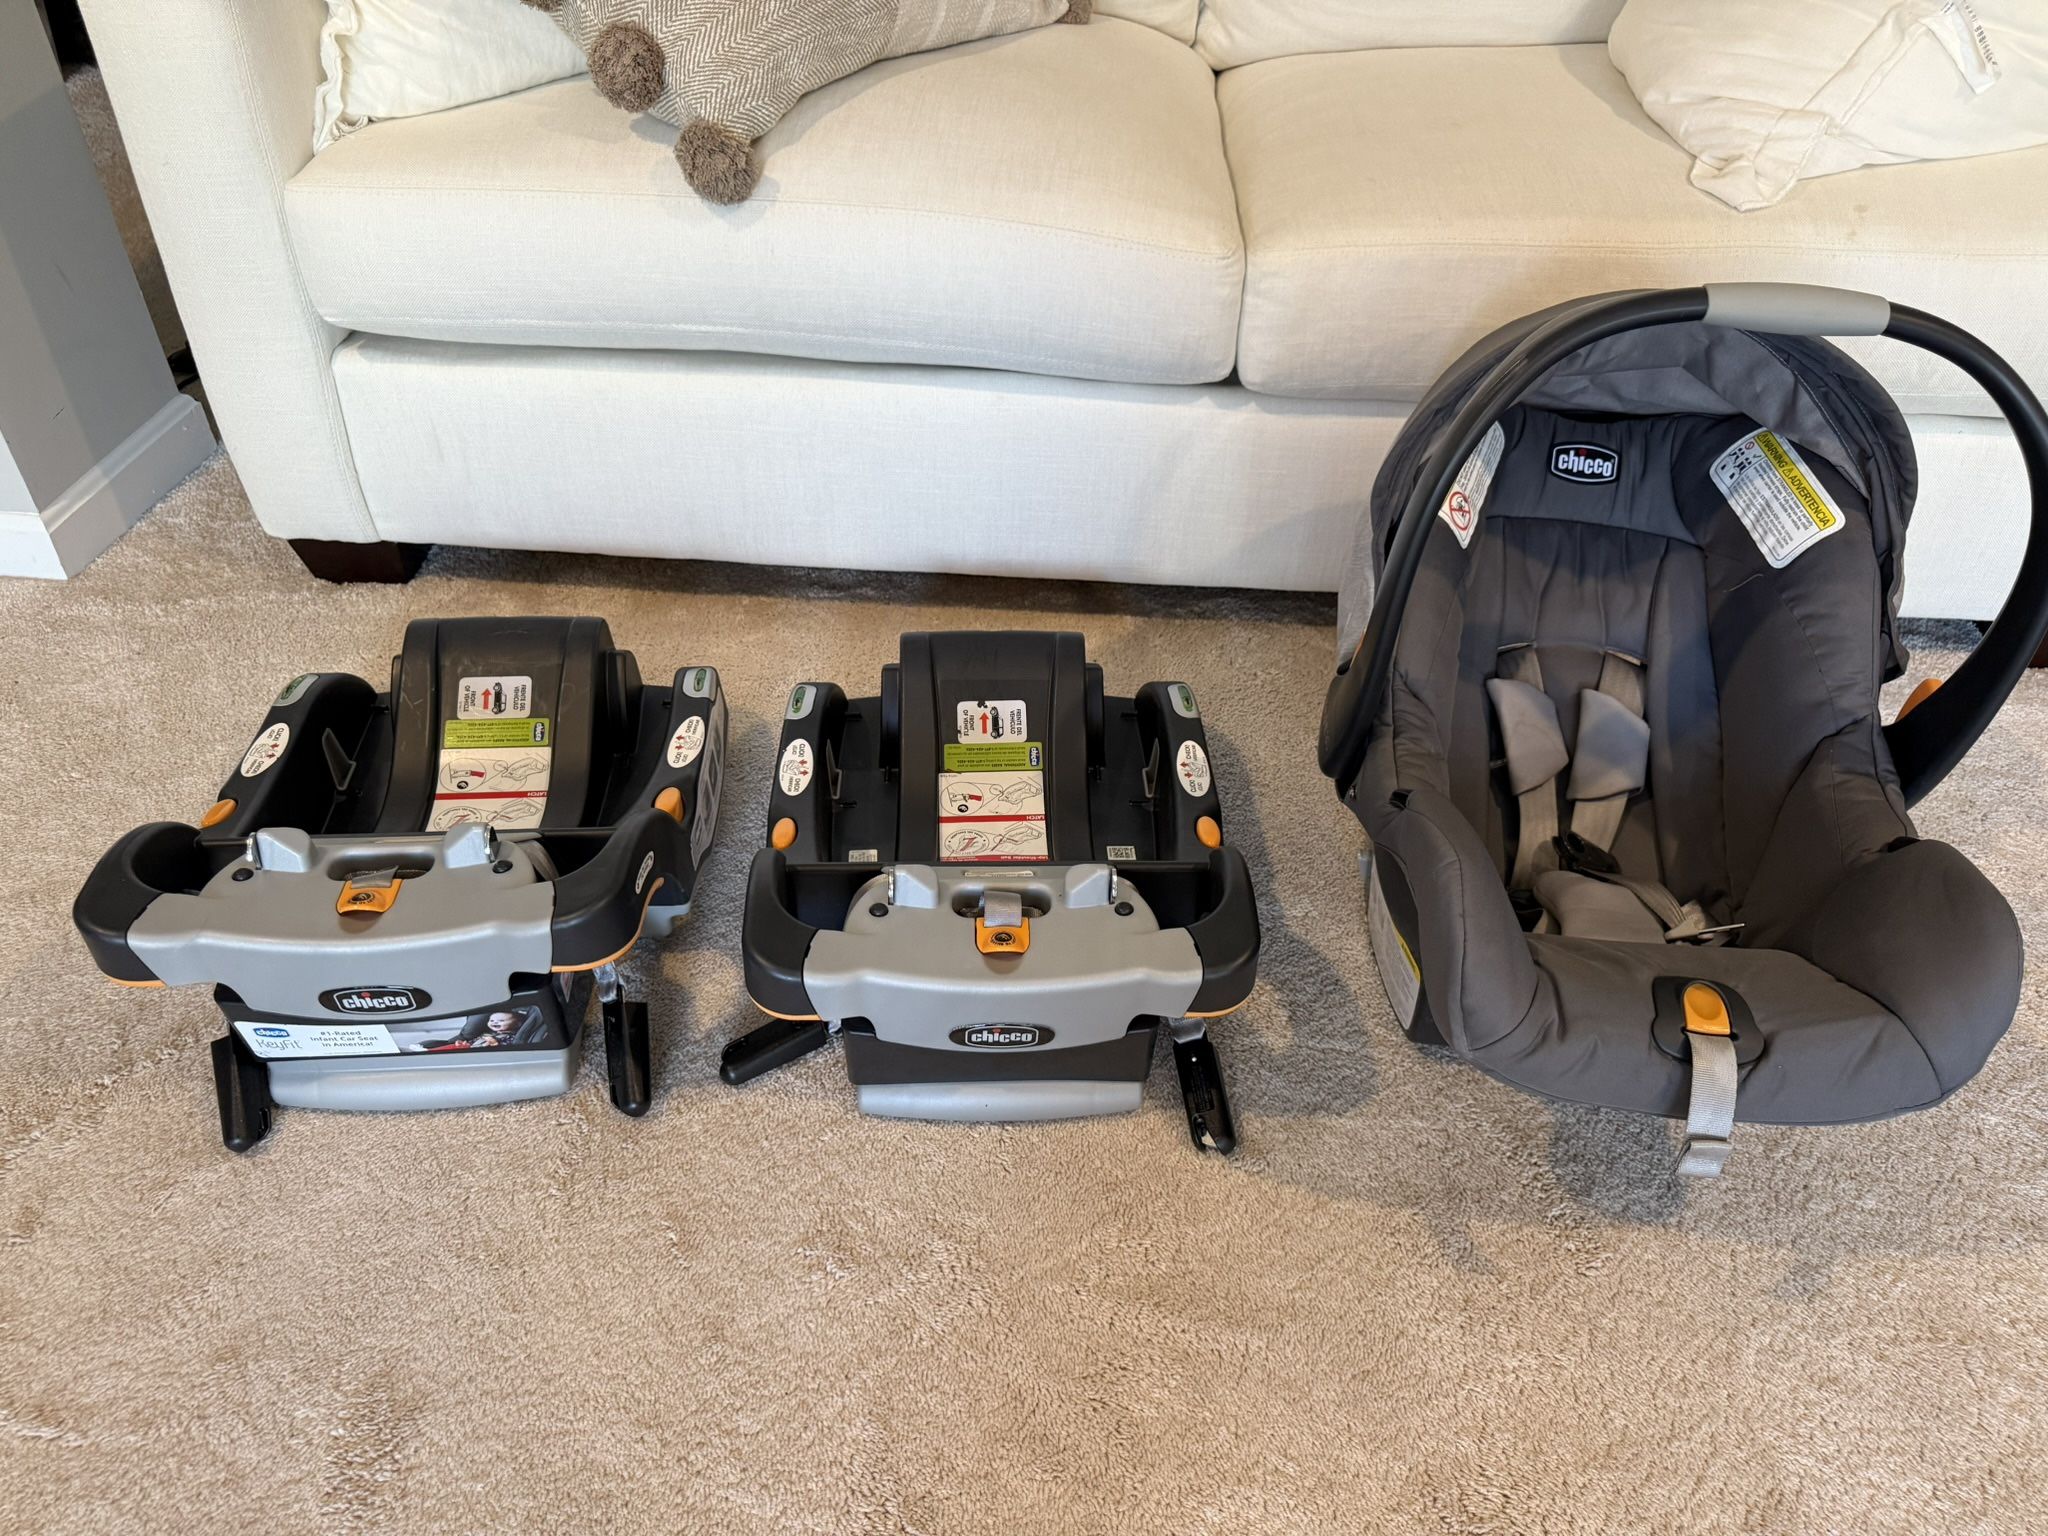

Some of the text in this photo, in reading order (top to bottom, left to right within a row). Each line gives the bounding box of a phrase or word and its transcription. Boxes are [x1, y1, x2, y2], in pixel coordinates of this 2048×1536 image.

[1558, 448, 1613, 477] chicco
[1761, 438, 1787, 468] WARNING
[1787, 474, 1831, 527] ADVERTENCIA
[342, 991, 409, 1010] chicco
[971, 1028, 1034, 1043] chicco
